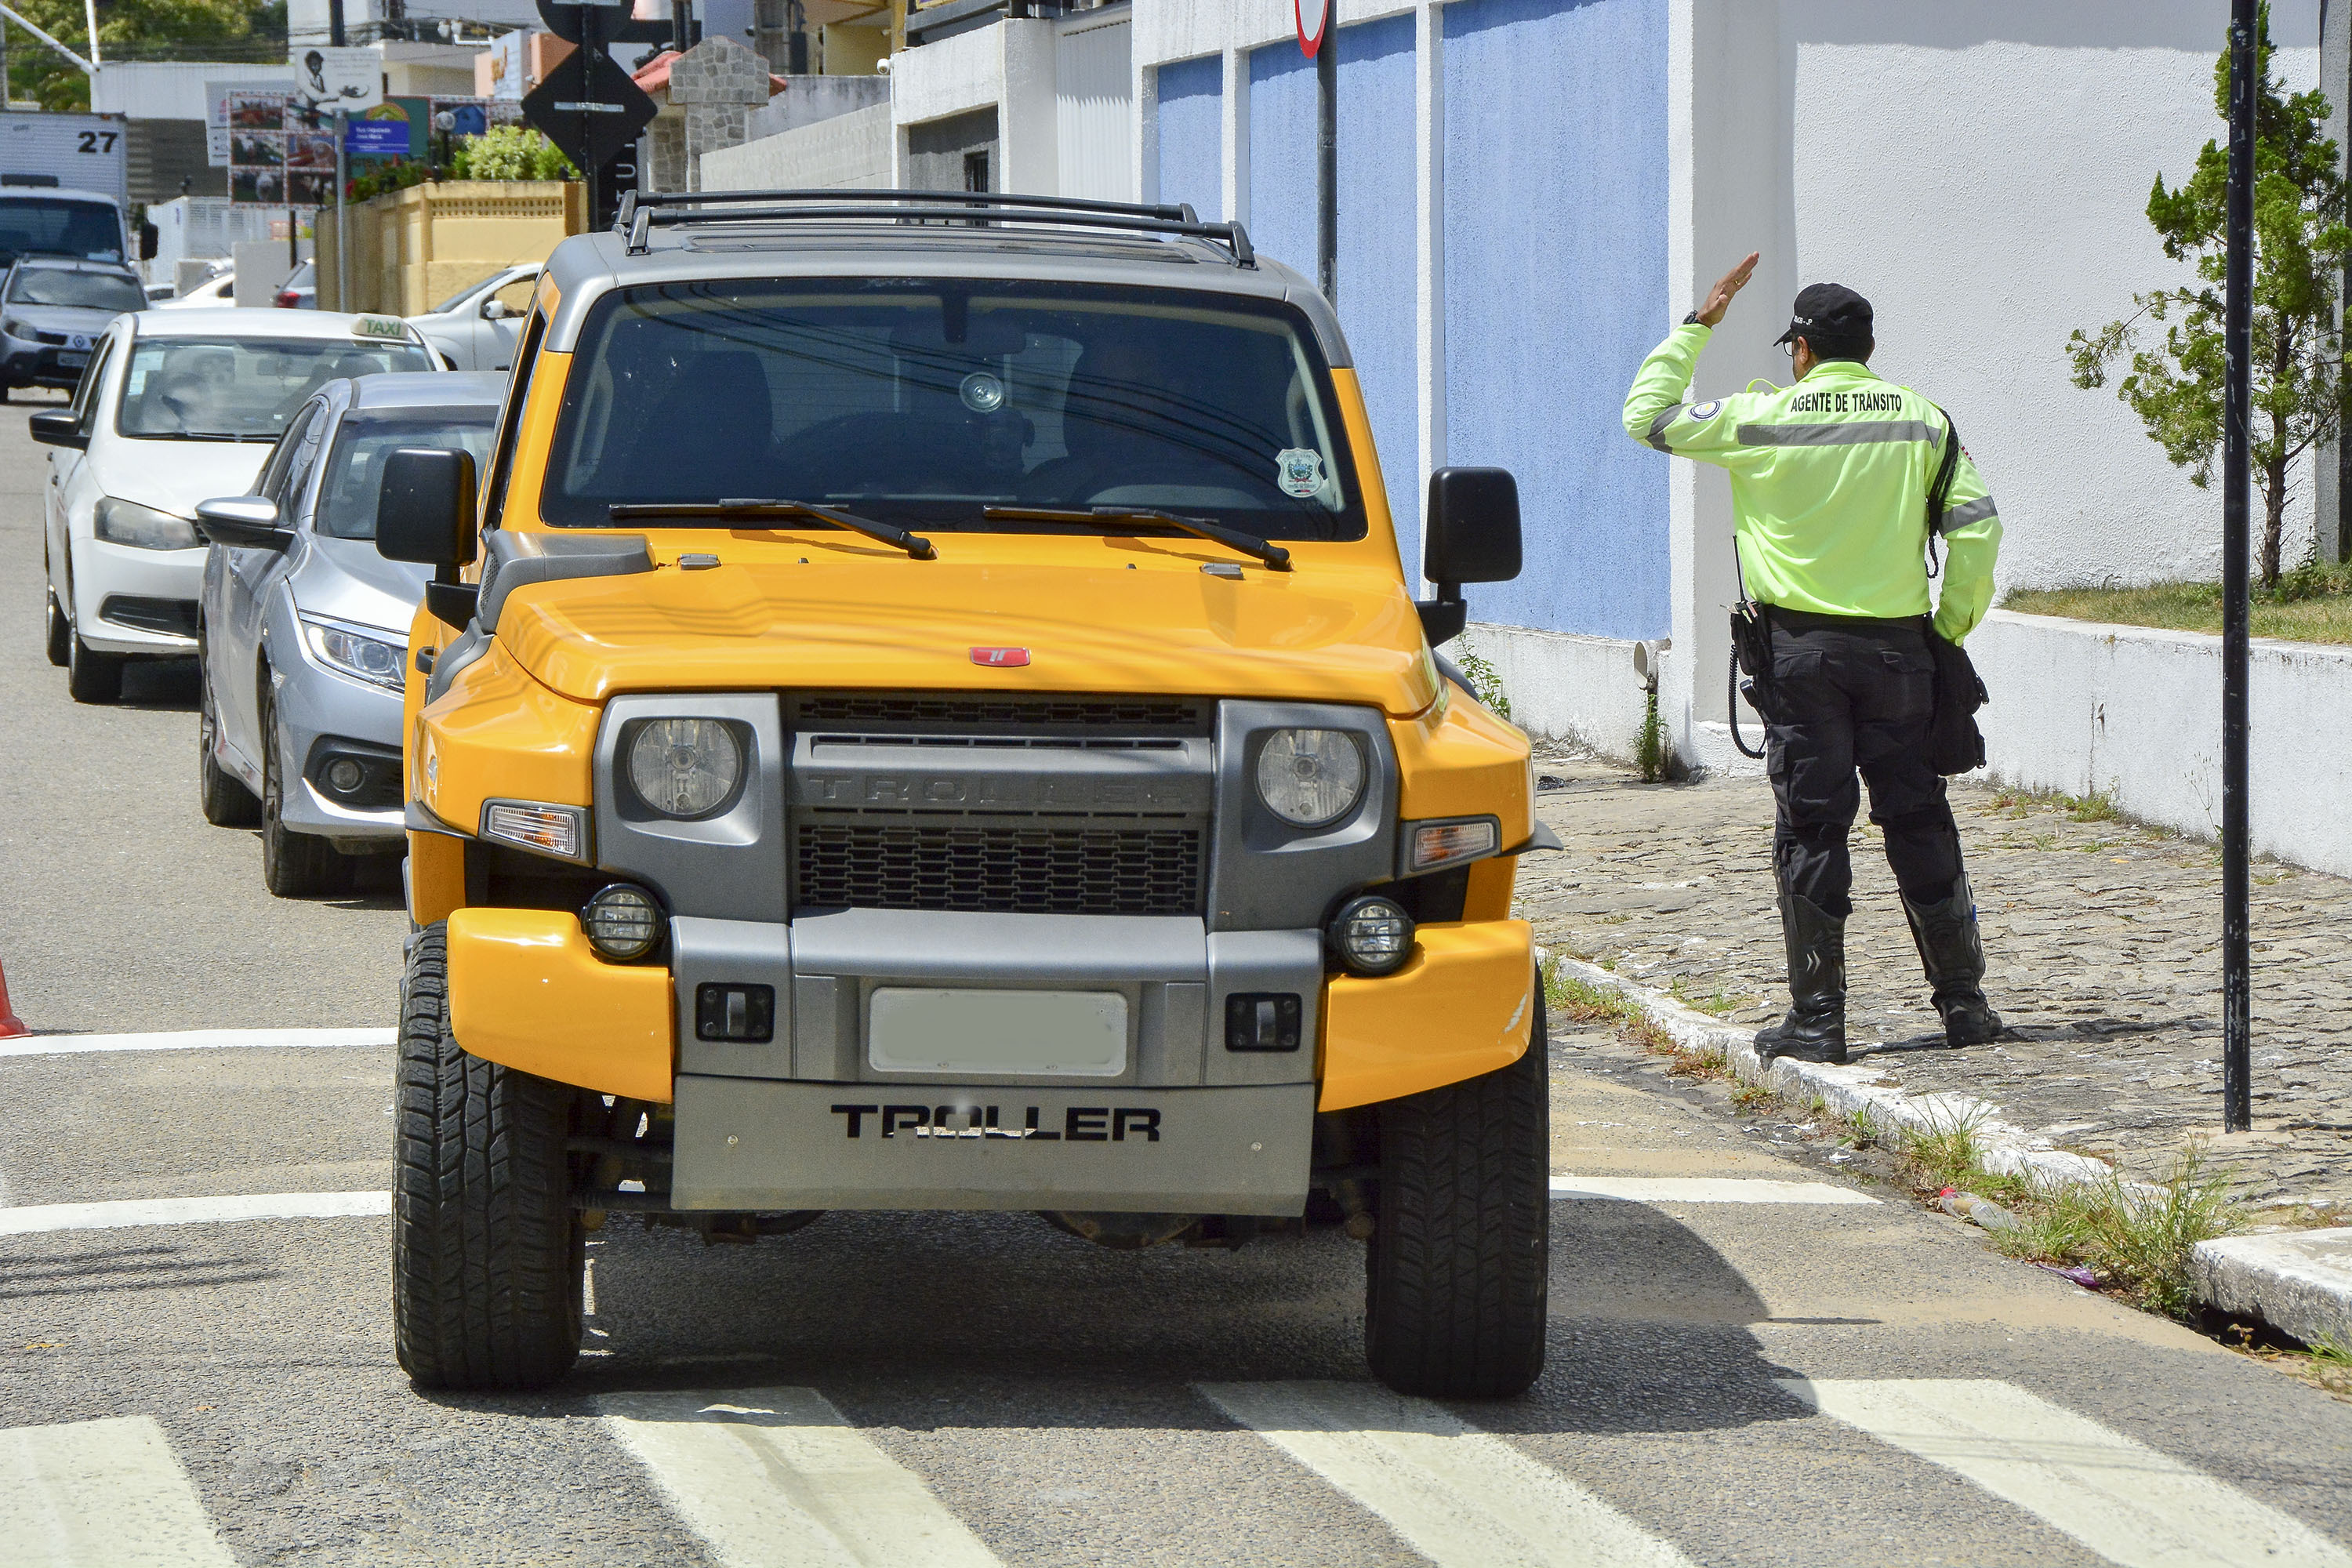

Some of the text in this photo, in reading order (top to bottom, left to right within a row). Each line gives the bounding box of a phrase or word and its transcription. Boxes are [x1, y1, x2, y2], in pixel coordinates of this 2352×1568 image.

[78, 130, 118, 153] 27
[364, 318, 401, 336] TAXI
[1791, 391, 1902, 412] AGENTE DE TRÂNSITO
[808, 775, 1193, 805] TROLLER
[830, 1104, 1161, 1142] TROLLER
